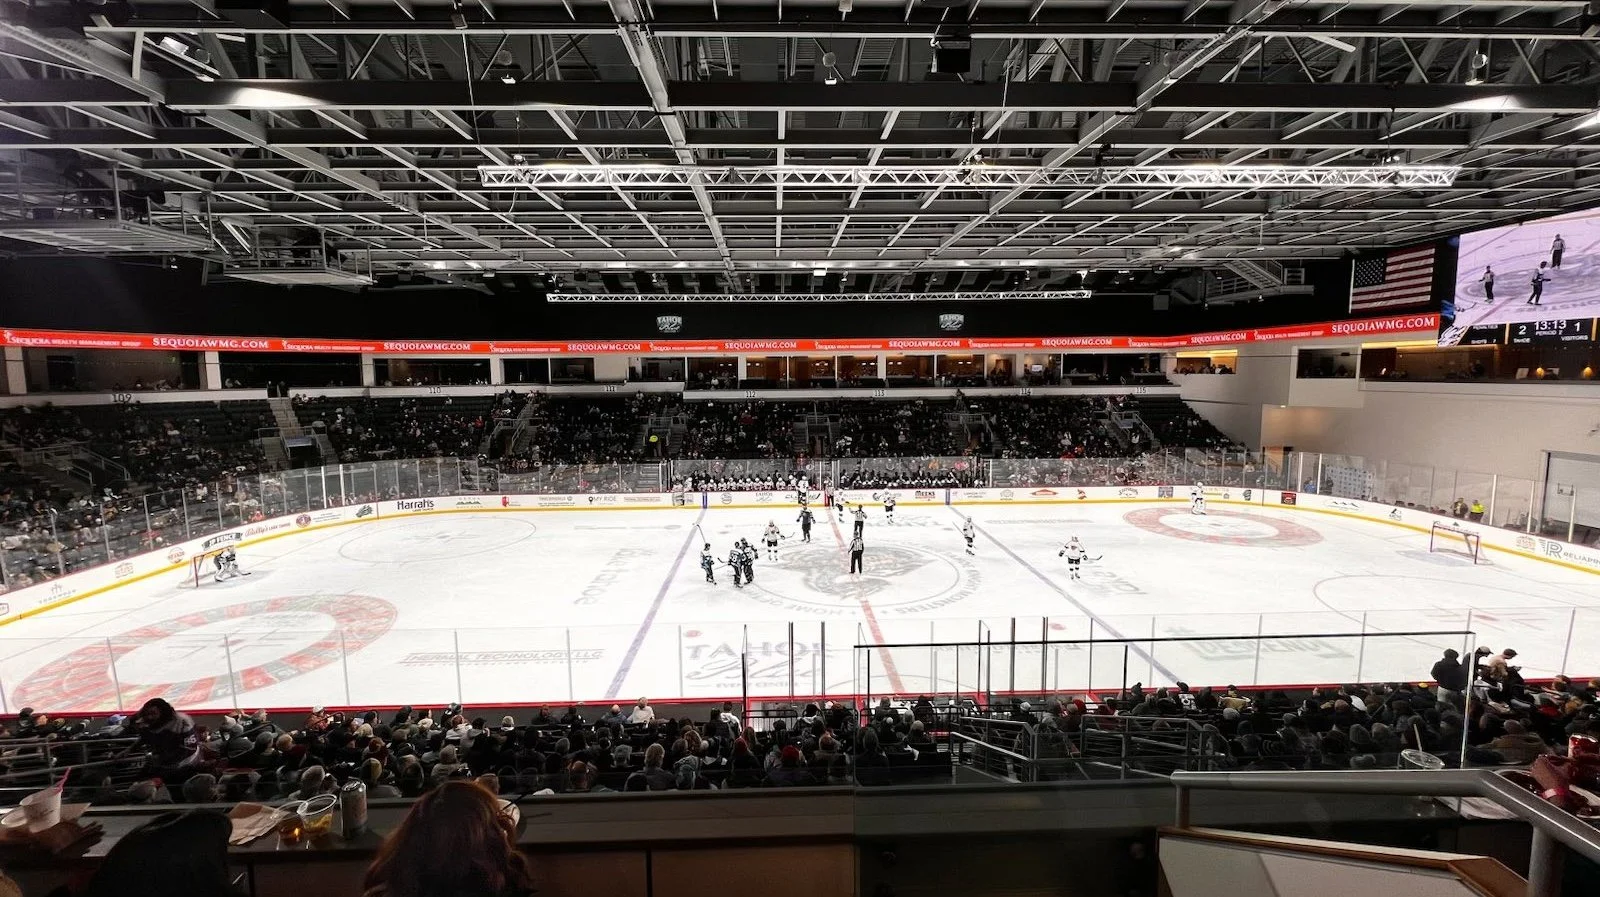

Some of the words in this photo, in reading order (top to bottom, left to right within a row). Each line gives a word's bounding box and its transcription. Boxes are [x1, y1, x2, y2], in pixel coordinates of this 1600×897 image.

[1331, 317, 1435, 334] SEQUOIAWMG.COM
[1519, 325, 1527, 335] 2
[1534, 320, 1566, 331] 13:13
[1574, 321, 1581, 332] 1
[11, 337, 51, 346] SEQUOIA
[152, 337, 269, 349] SEQUOIAWMG.COM
[1041, 338, 1113, 347] SEQUOIAWMG.COM
[1191, 332, 1247, 344] SEQUOIAWMG.COM
[383, 342, 470, 351] SEQUOIAWMG.COM
[567, 343, 641, 352] SEQUOIAWMG.COM
[724, 342, 797, 350] SEQUOIAWMG.COM
[888, 340, 961, 348] SEQUOIAWMG.COM
[112, 393, 132, 403] 109
[685, 641, 834, 660] TAHOE
